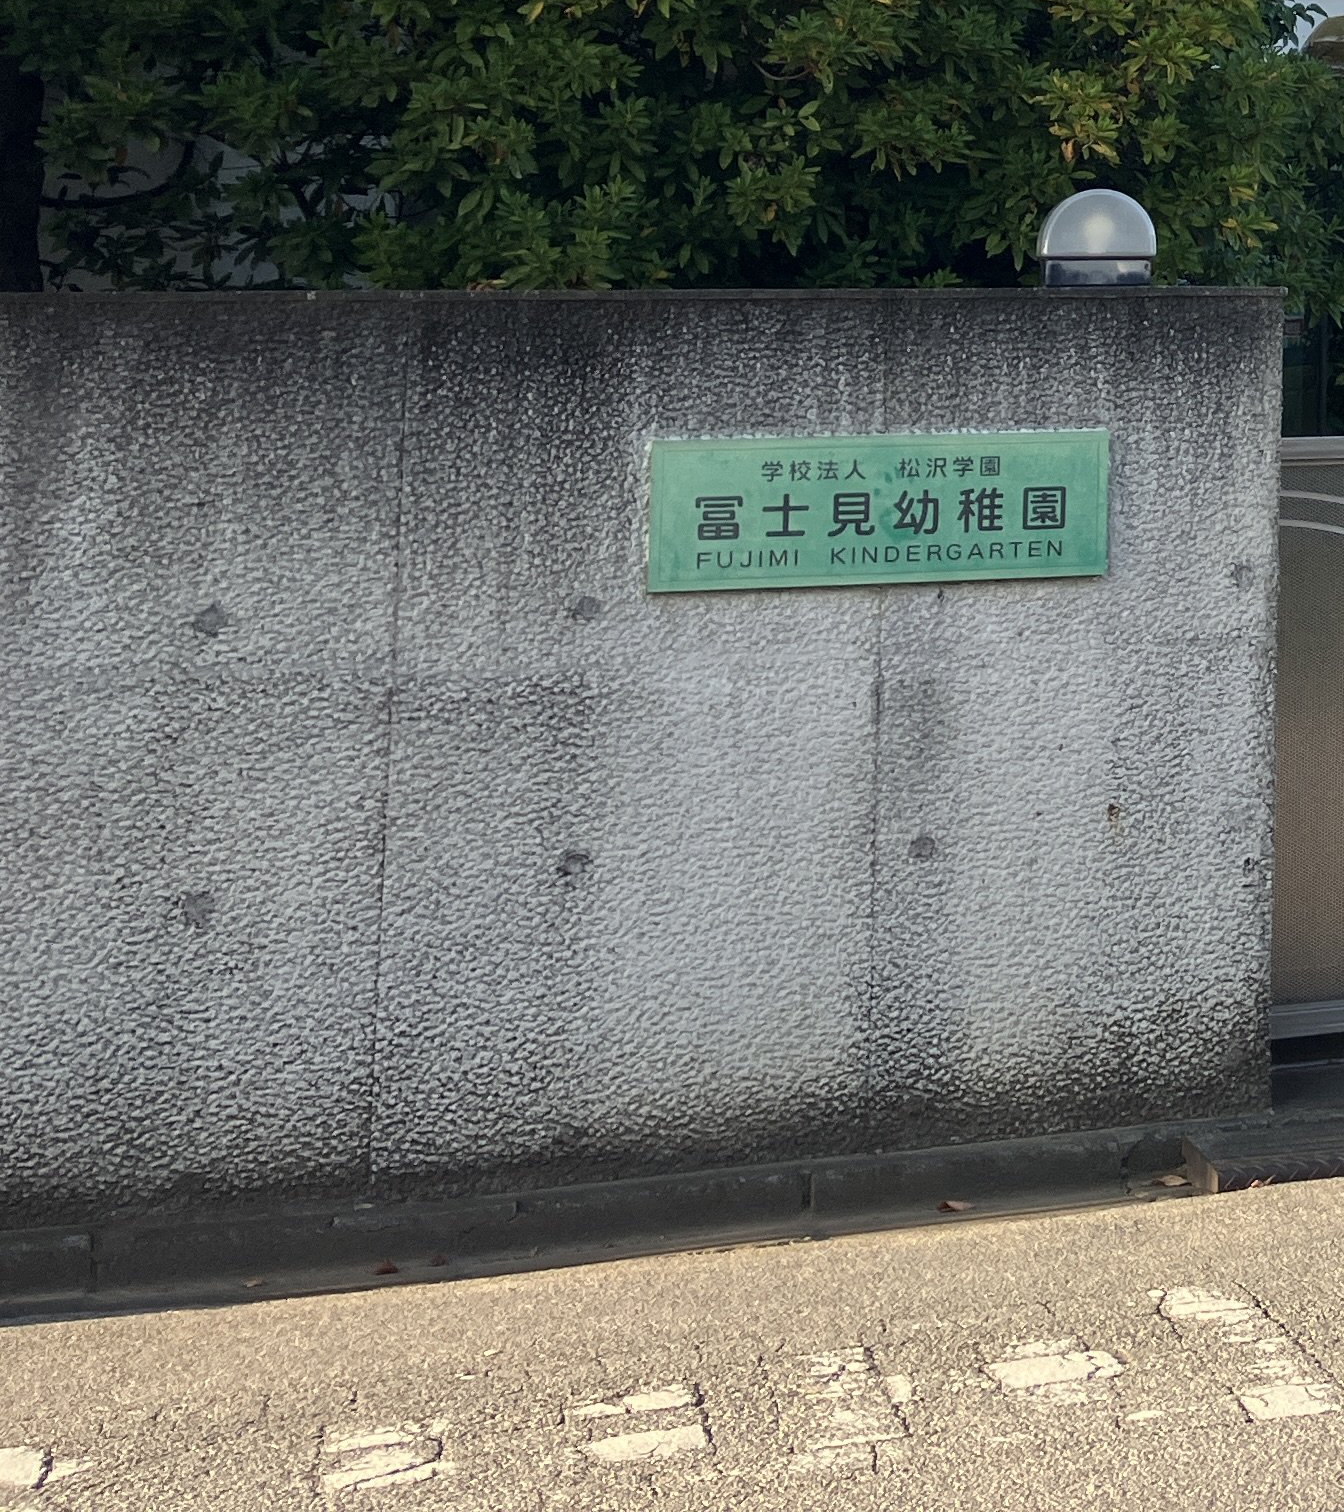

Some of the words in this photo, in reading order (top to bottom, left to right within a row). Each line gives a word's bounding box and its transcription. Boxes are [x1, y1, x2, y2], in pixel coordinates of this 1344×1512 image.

[761, 458, 866, 482] 学校法人
[899, 455, 1000, 479] 松沢学園
[696, 548, 799, 570] FUJIMI
[830, 539, 1063, 565] KINDERGARTEN
